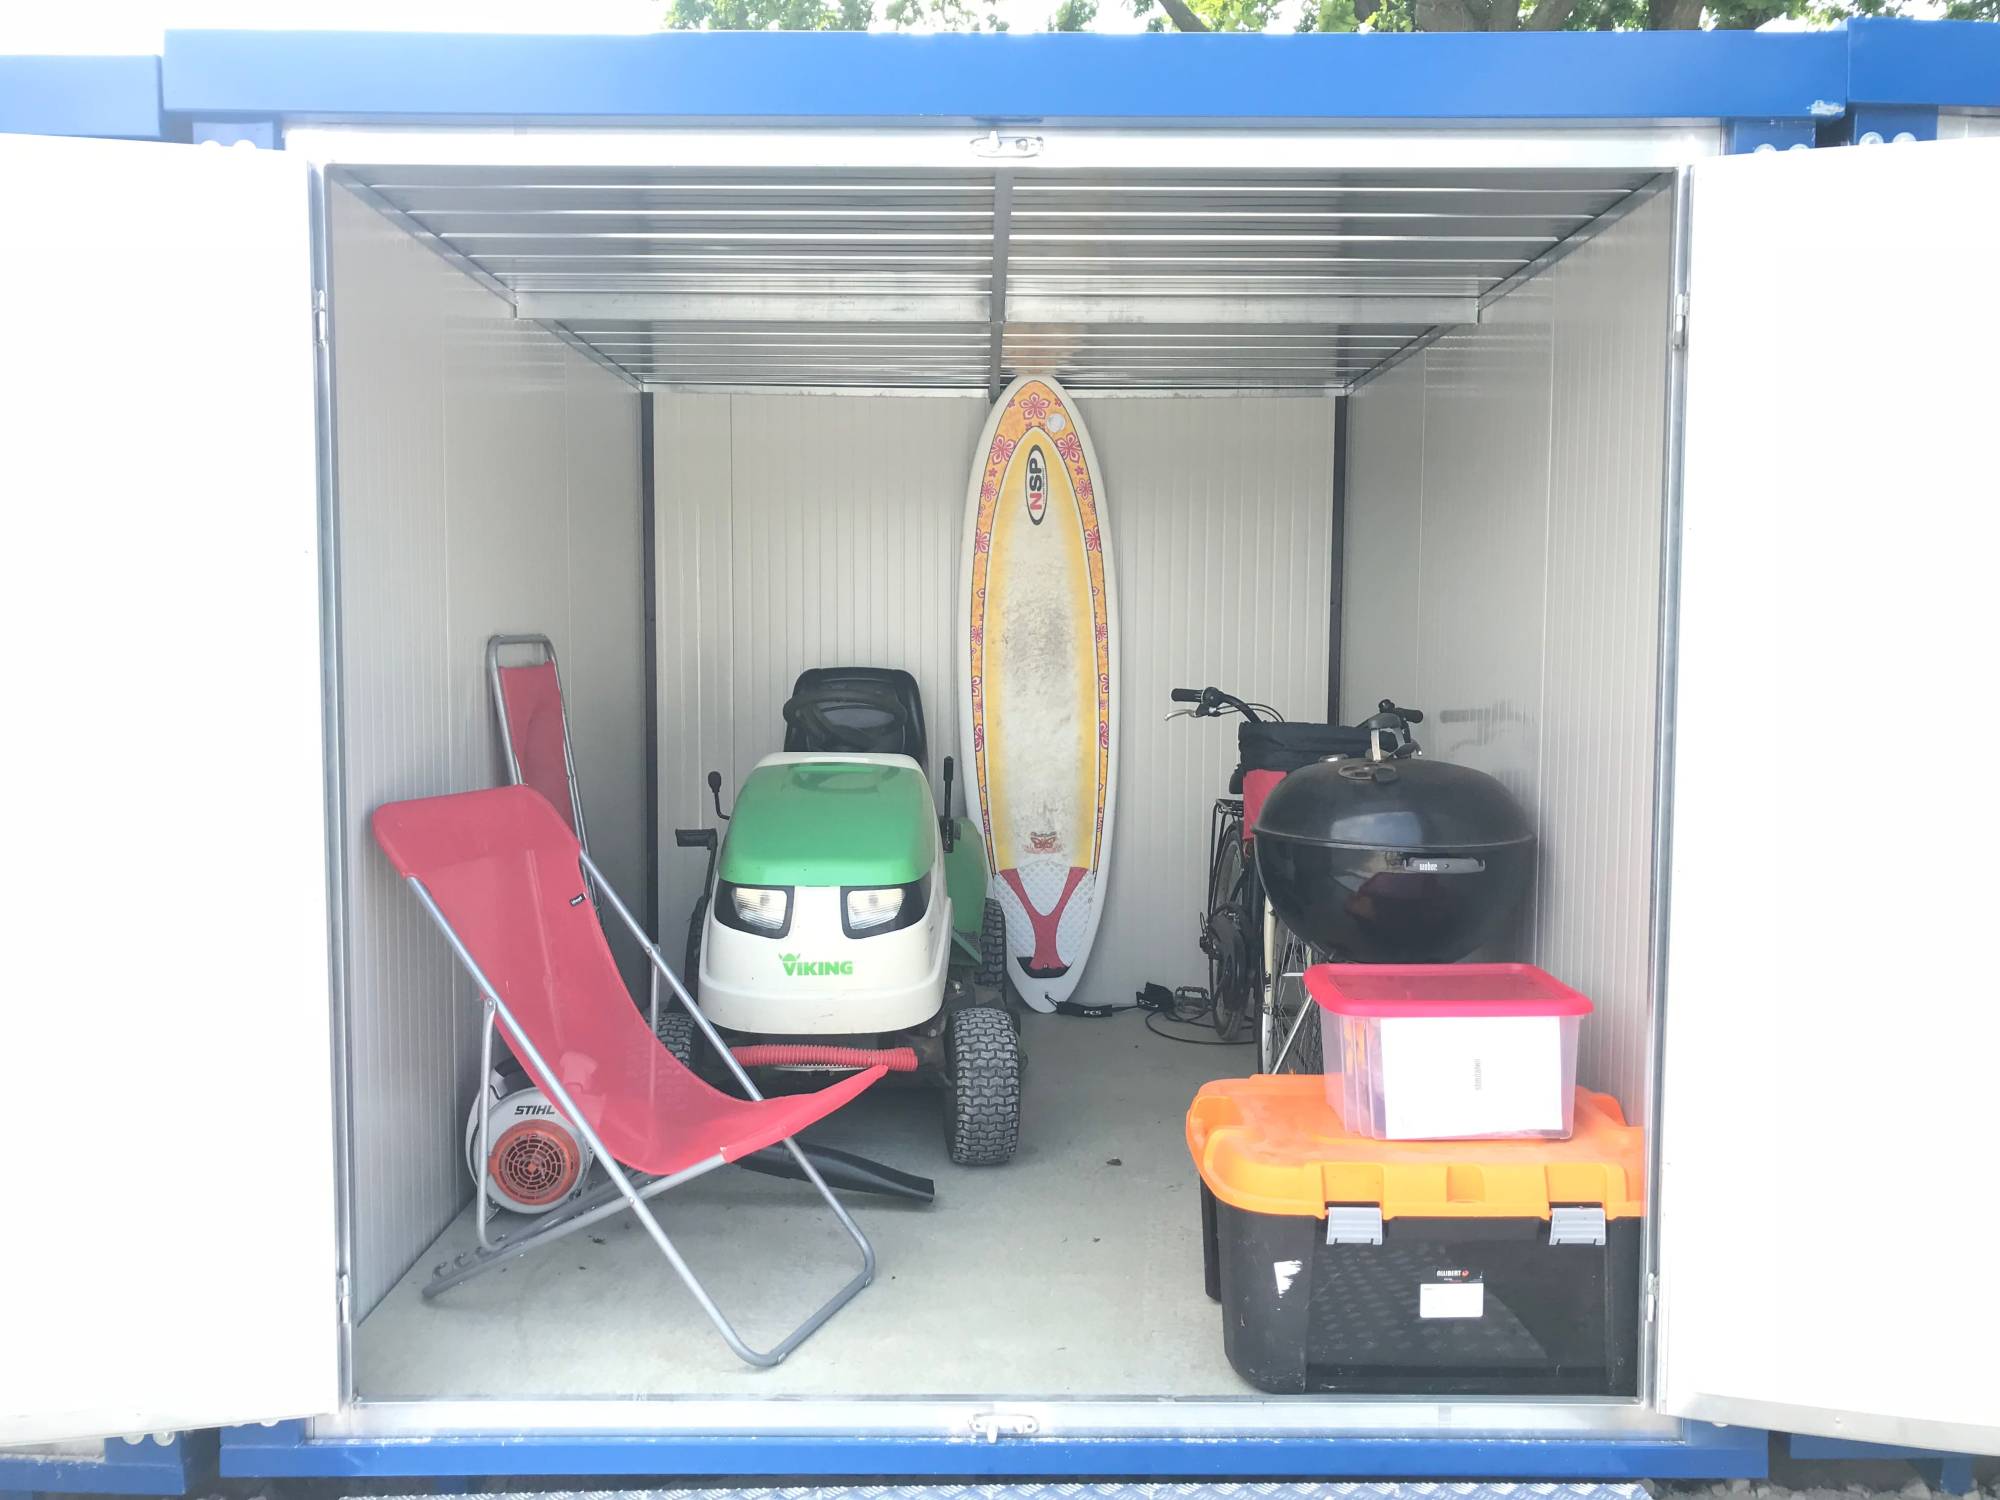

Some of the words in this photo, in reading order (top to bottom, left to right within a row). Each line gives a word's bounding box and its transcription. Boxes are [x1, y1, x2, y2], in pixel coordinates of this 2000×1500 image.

[1029, 457, 1043, 511] NSP
[782, 960, 854, 977] VIKING
[514, 1104, 555, 1115] STIHL
